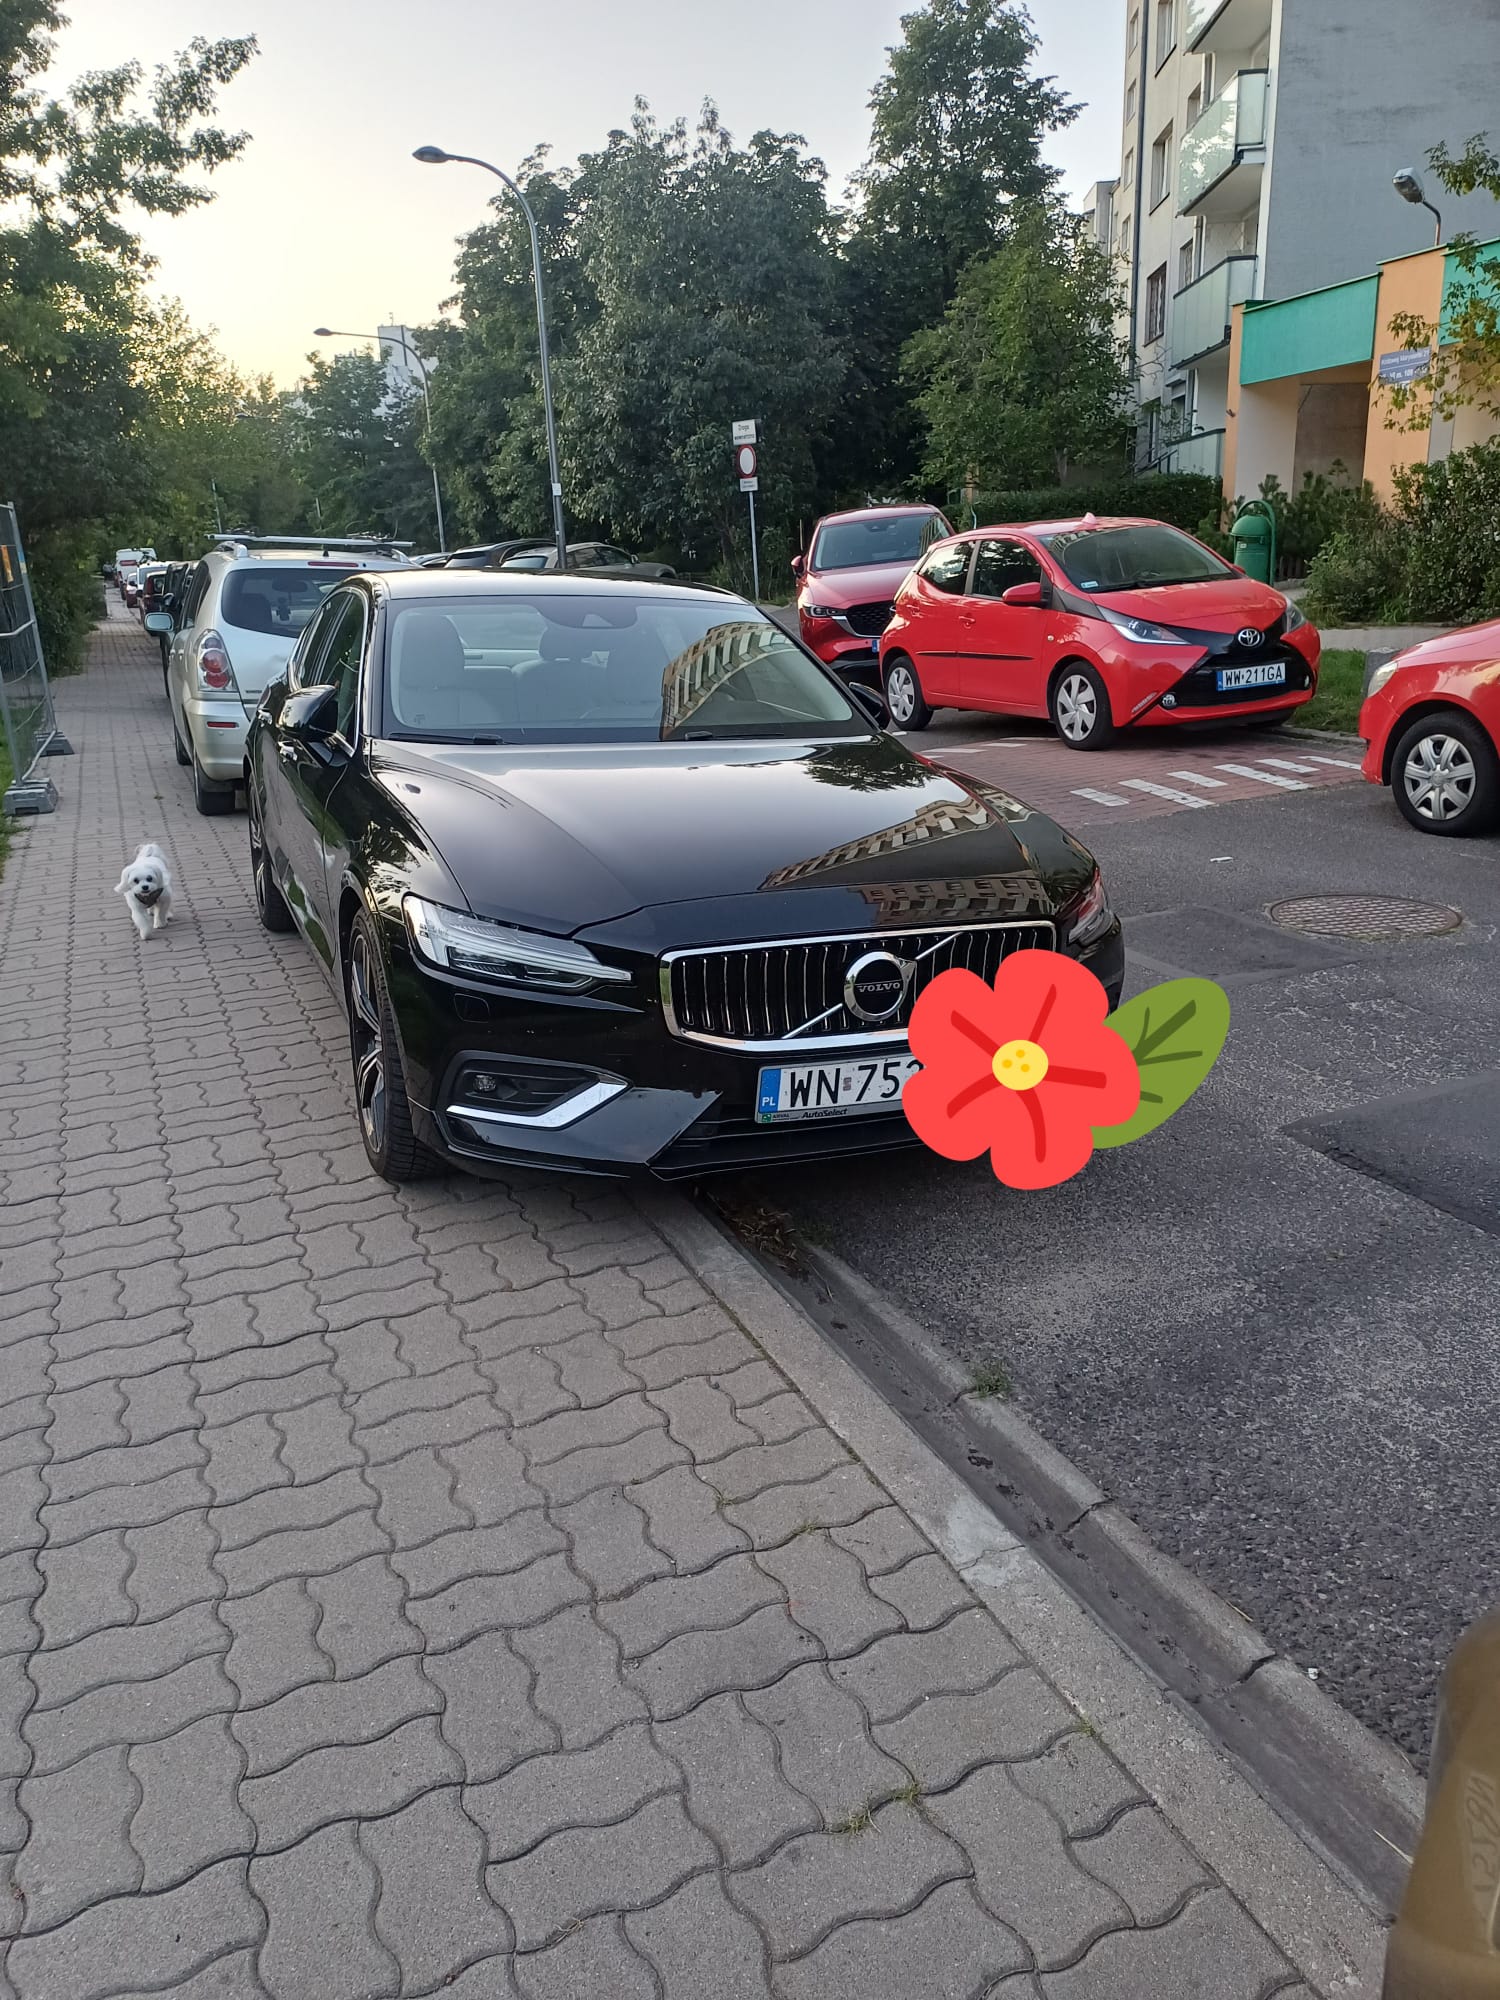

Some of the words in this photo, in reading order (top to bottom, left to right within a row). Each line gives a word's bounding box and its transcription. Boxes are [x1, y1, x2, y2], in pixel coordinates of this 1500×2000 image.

[1225, 671, 1241, 687] WW
[1245, 665, 1282, 684] 211GA
[857, 982, 900, 993] VOLVO
[790, 1068, 841, 1108] WN
[761, 1096, 776, 1107] PL
[802, 1108, 848, 1118] AutoSelect
